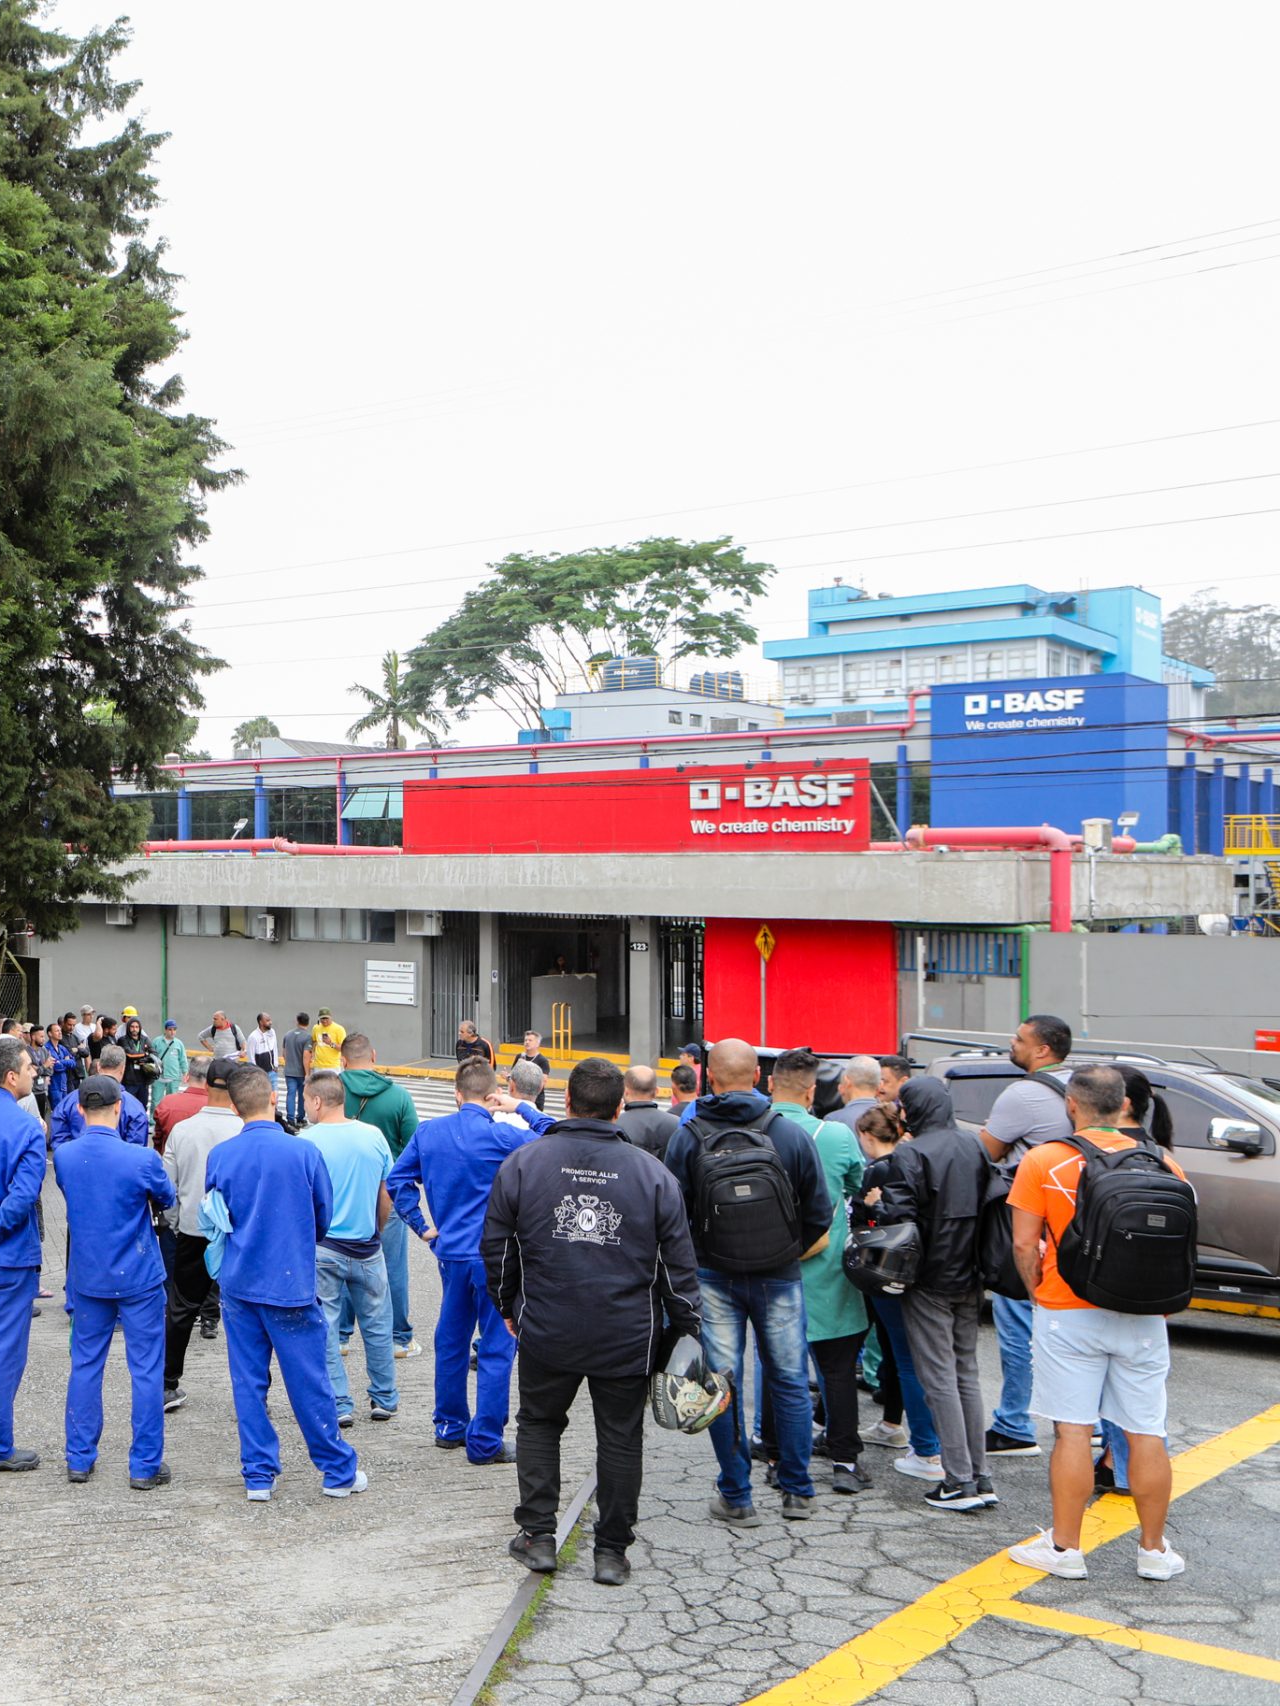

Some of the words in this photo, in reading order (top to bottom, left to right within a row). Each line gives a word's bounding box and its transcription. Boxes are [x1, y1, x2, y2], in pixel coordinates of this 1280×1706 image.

[1004, 689, 1085, 713] BASF
[965, 720, 984, 730] We
[987, 719, 1024, 730] create
[1026, 716, 1085, 728] chemistry
[744, 774, 855, 808] BASF
[690, 820, 716, 834] We
[719, 819, 769, 834] create
[772, 817, 855, 835] chemistry
[632, 943, 646, 951] 123
[561, 1167, 597, 1177] PROMOTOR
[598, 1171, 619, 1180] ALLIS
[578, 1176, 607, 1185] SERVIÇO
